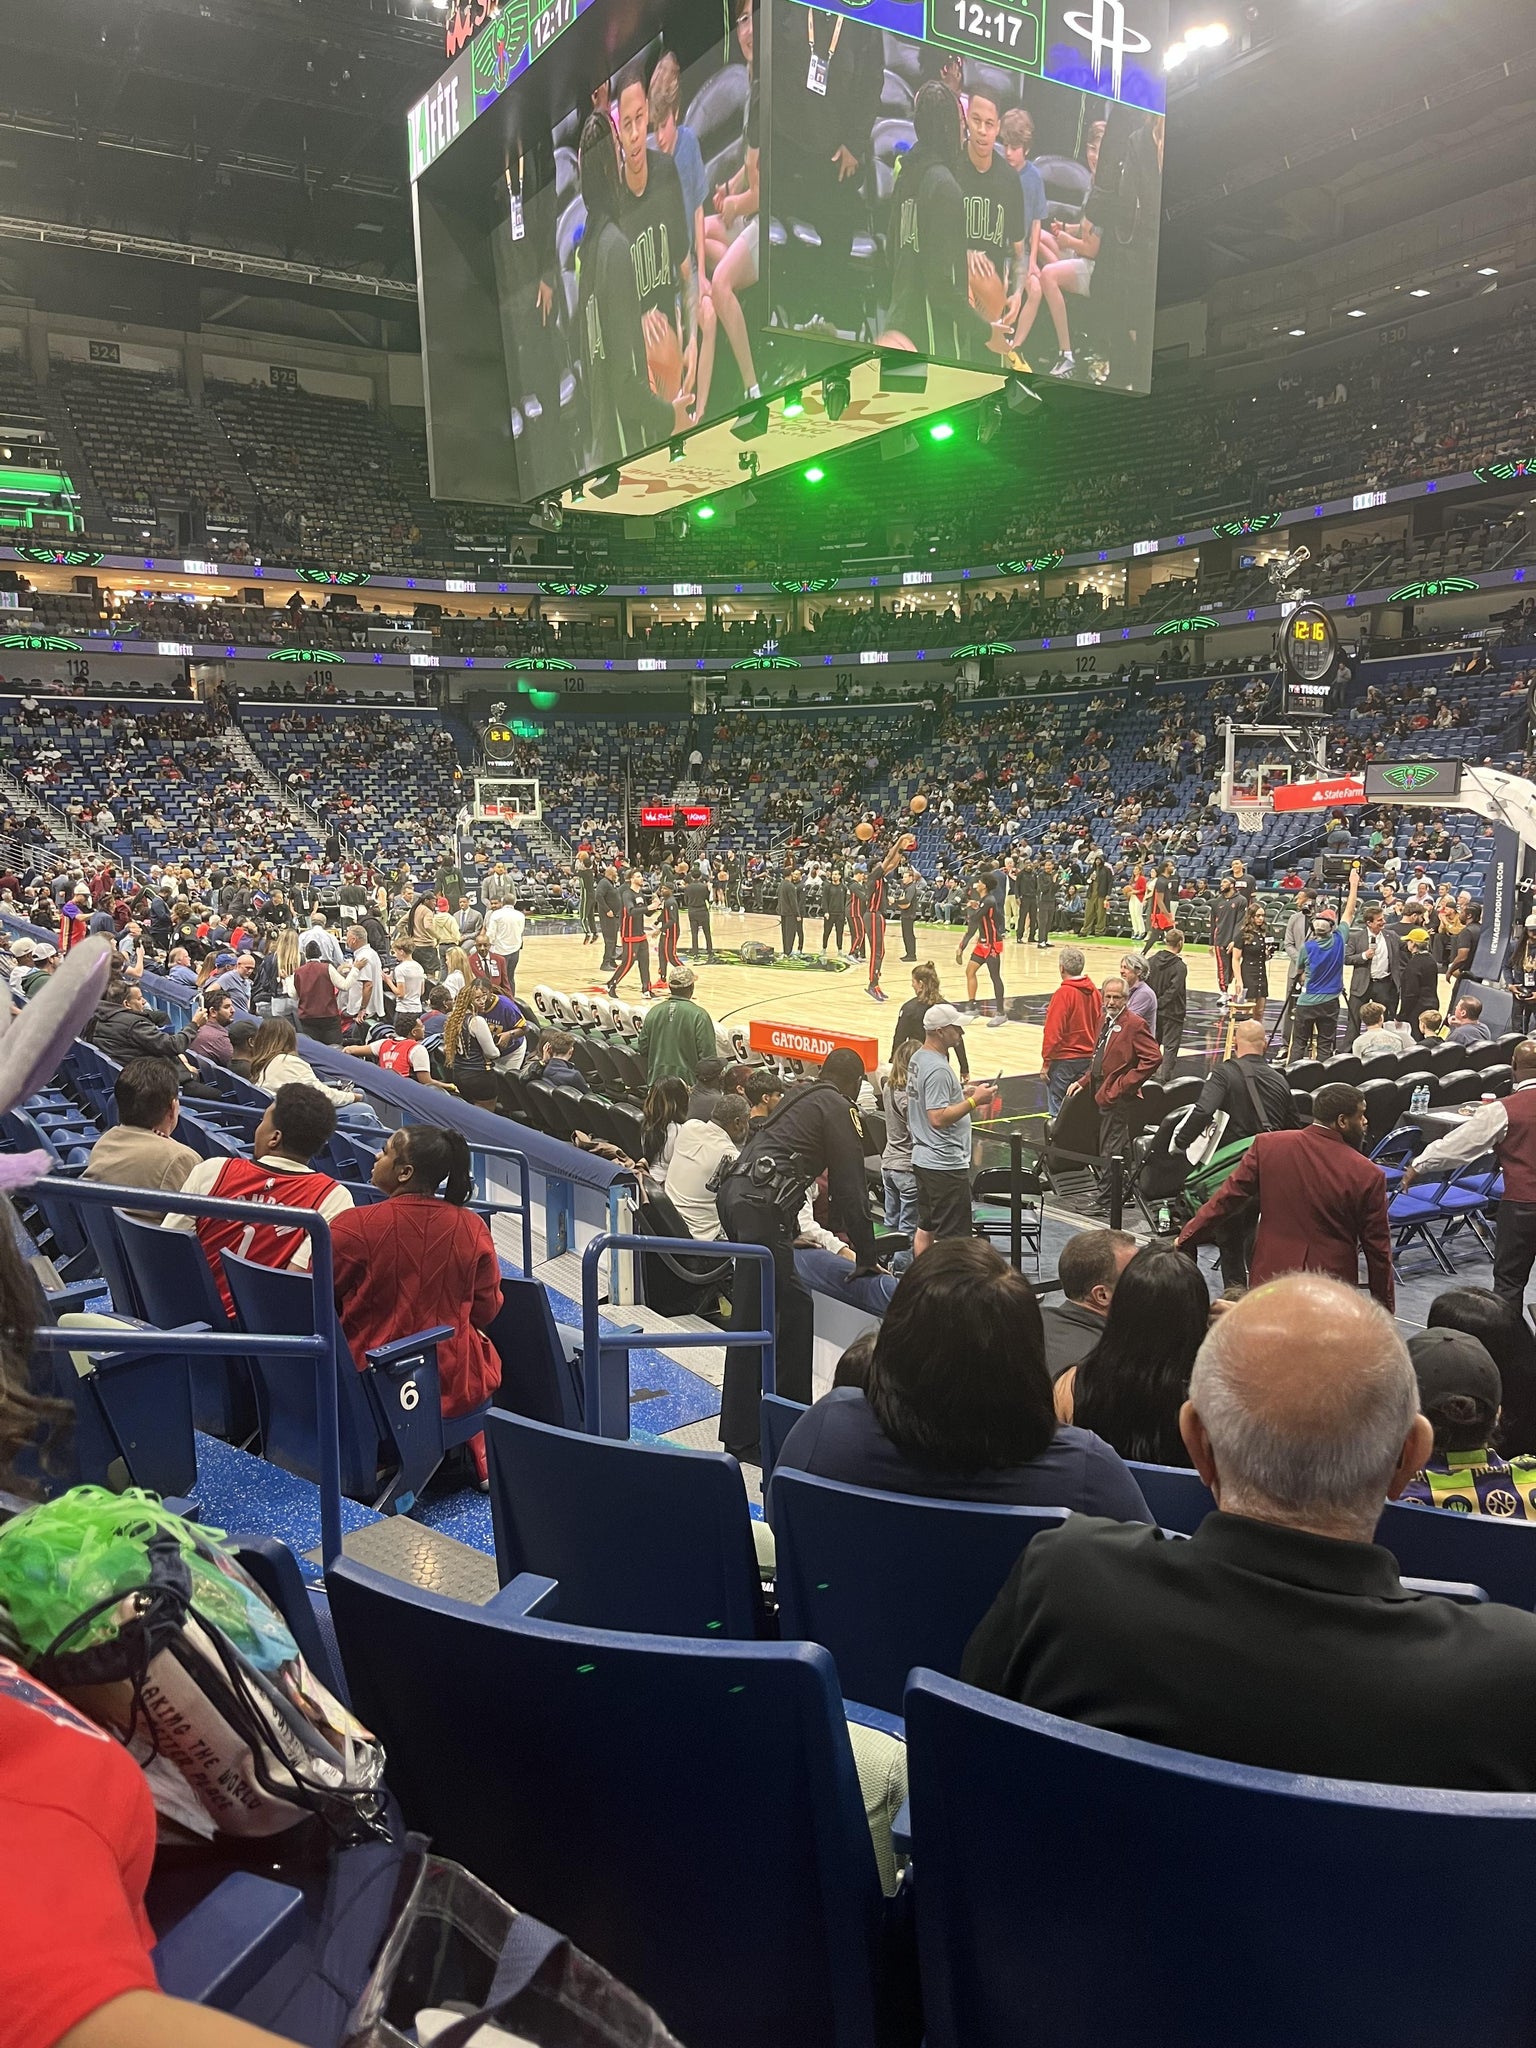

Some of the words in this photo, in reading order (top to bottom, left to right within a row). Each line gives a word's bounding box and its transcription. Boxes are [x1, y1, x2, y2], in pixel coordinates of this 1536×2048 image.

[535, 0, 571, 48] 12:17
[953, 0, 1023, 47] 12:17
[90, 344, 119, 360] 324
[271, 369, 296, 384] 325
[1295, 621, 1325, 641] 12:16
[66, 659, 90, 676] 118
[1076, 656, 1096, 672] 122
[313, 670, 333, 684] 119
[563, 677, 584, 692] 120
[835, 673, 853, 688] 121
[1301, 685, 1331, 696] TISSOT
[1323, 789, 1344, 800] State
[771, 1031, 836, 1056] GATORADE
[400, 1380, 419, 1411] 6
[141, 1675, 192, 1736] AKING
[188, 1738, 220, 1770] THE
[218, 1768, 262, 1810] WORLD
